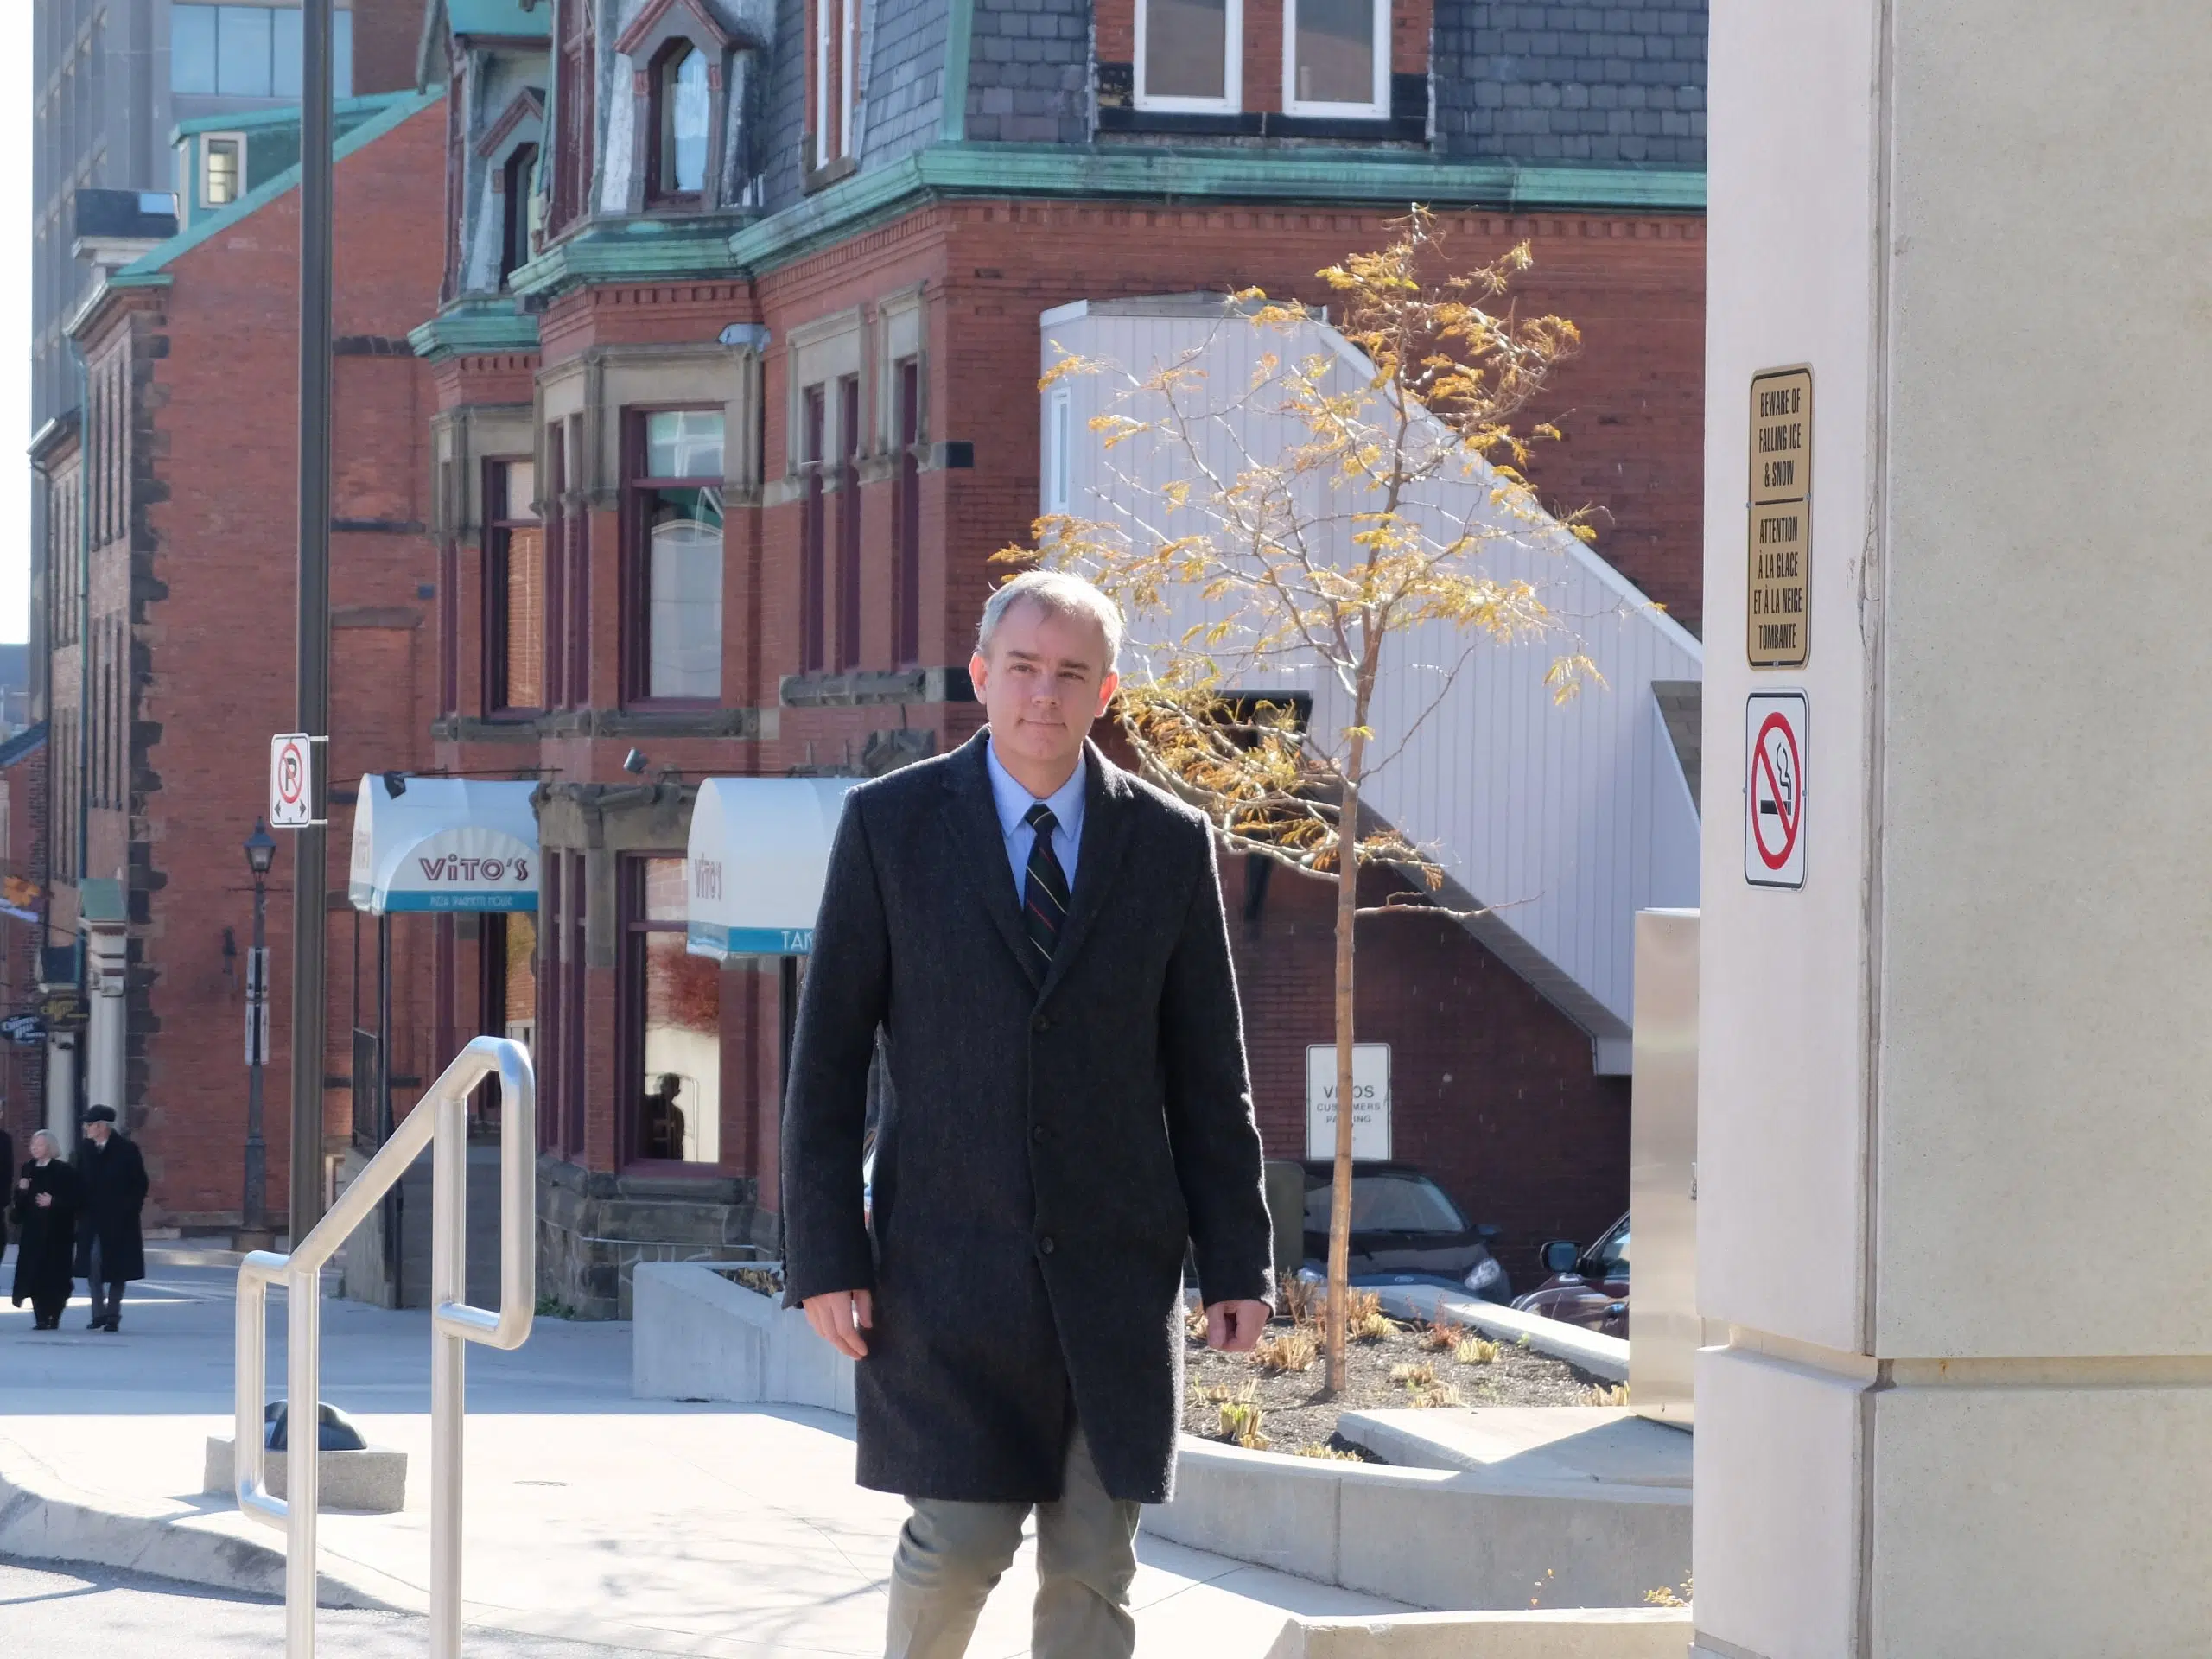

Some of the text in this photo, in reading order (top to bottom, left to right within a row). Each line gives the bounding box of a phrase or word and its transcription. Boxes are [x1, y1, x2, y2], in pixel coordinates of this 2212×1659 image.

[1760, 387, 1802, 417] BEWARE OF
[1759, 423, 1802, 453] FALLING ICE
[1764, 460, 1795, 487] & SNOW
[1759, 516, 1798, 544] ATTENTION
[1765, 553, 1775, 579] LA
[1777, 552, 1798, 578] GLACE
[1753, 589, 1761, 615] ET
[1771, 589, 1780, 614] LA
[1782, 587, 1802, 613] NEIGE
[1758, 623, 1796, 651] TOMBANTE
[1323, 1085, 1375, 1099] VIOS
[1316, 1102, 1381, 1112] CUSMERS
